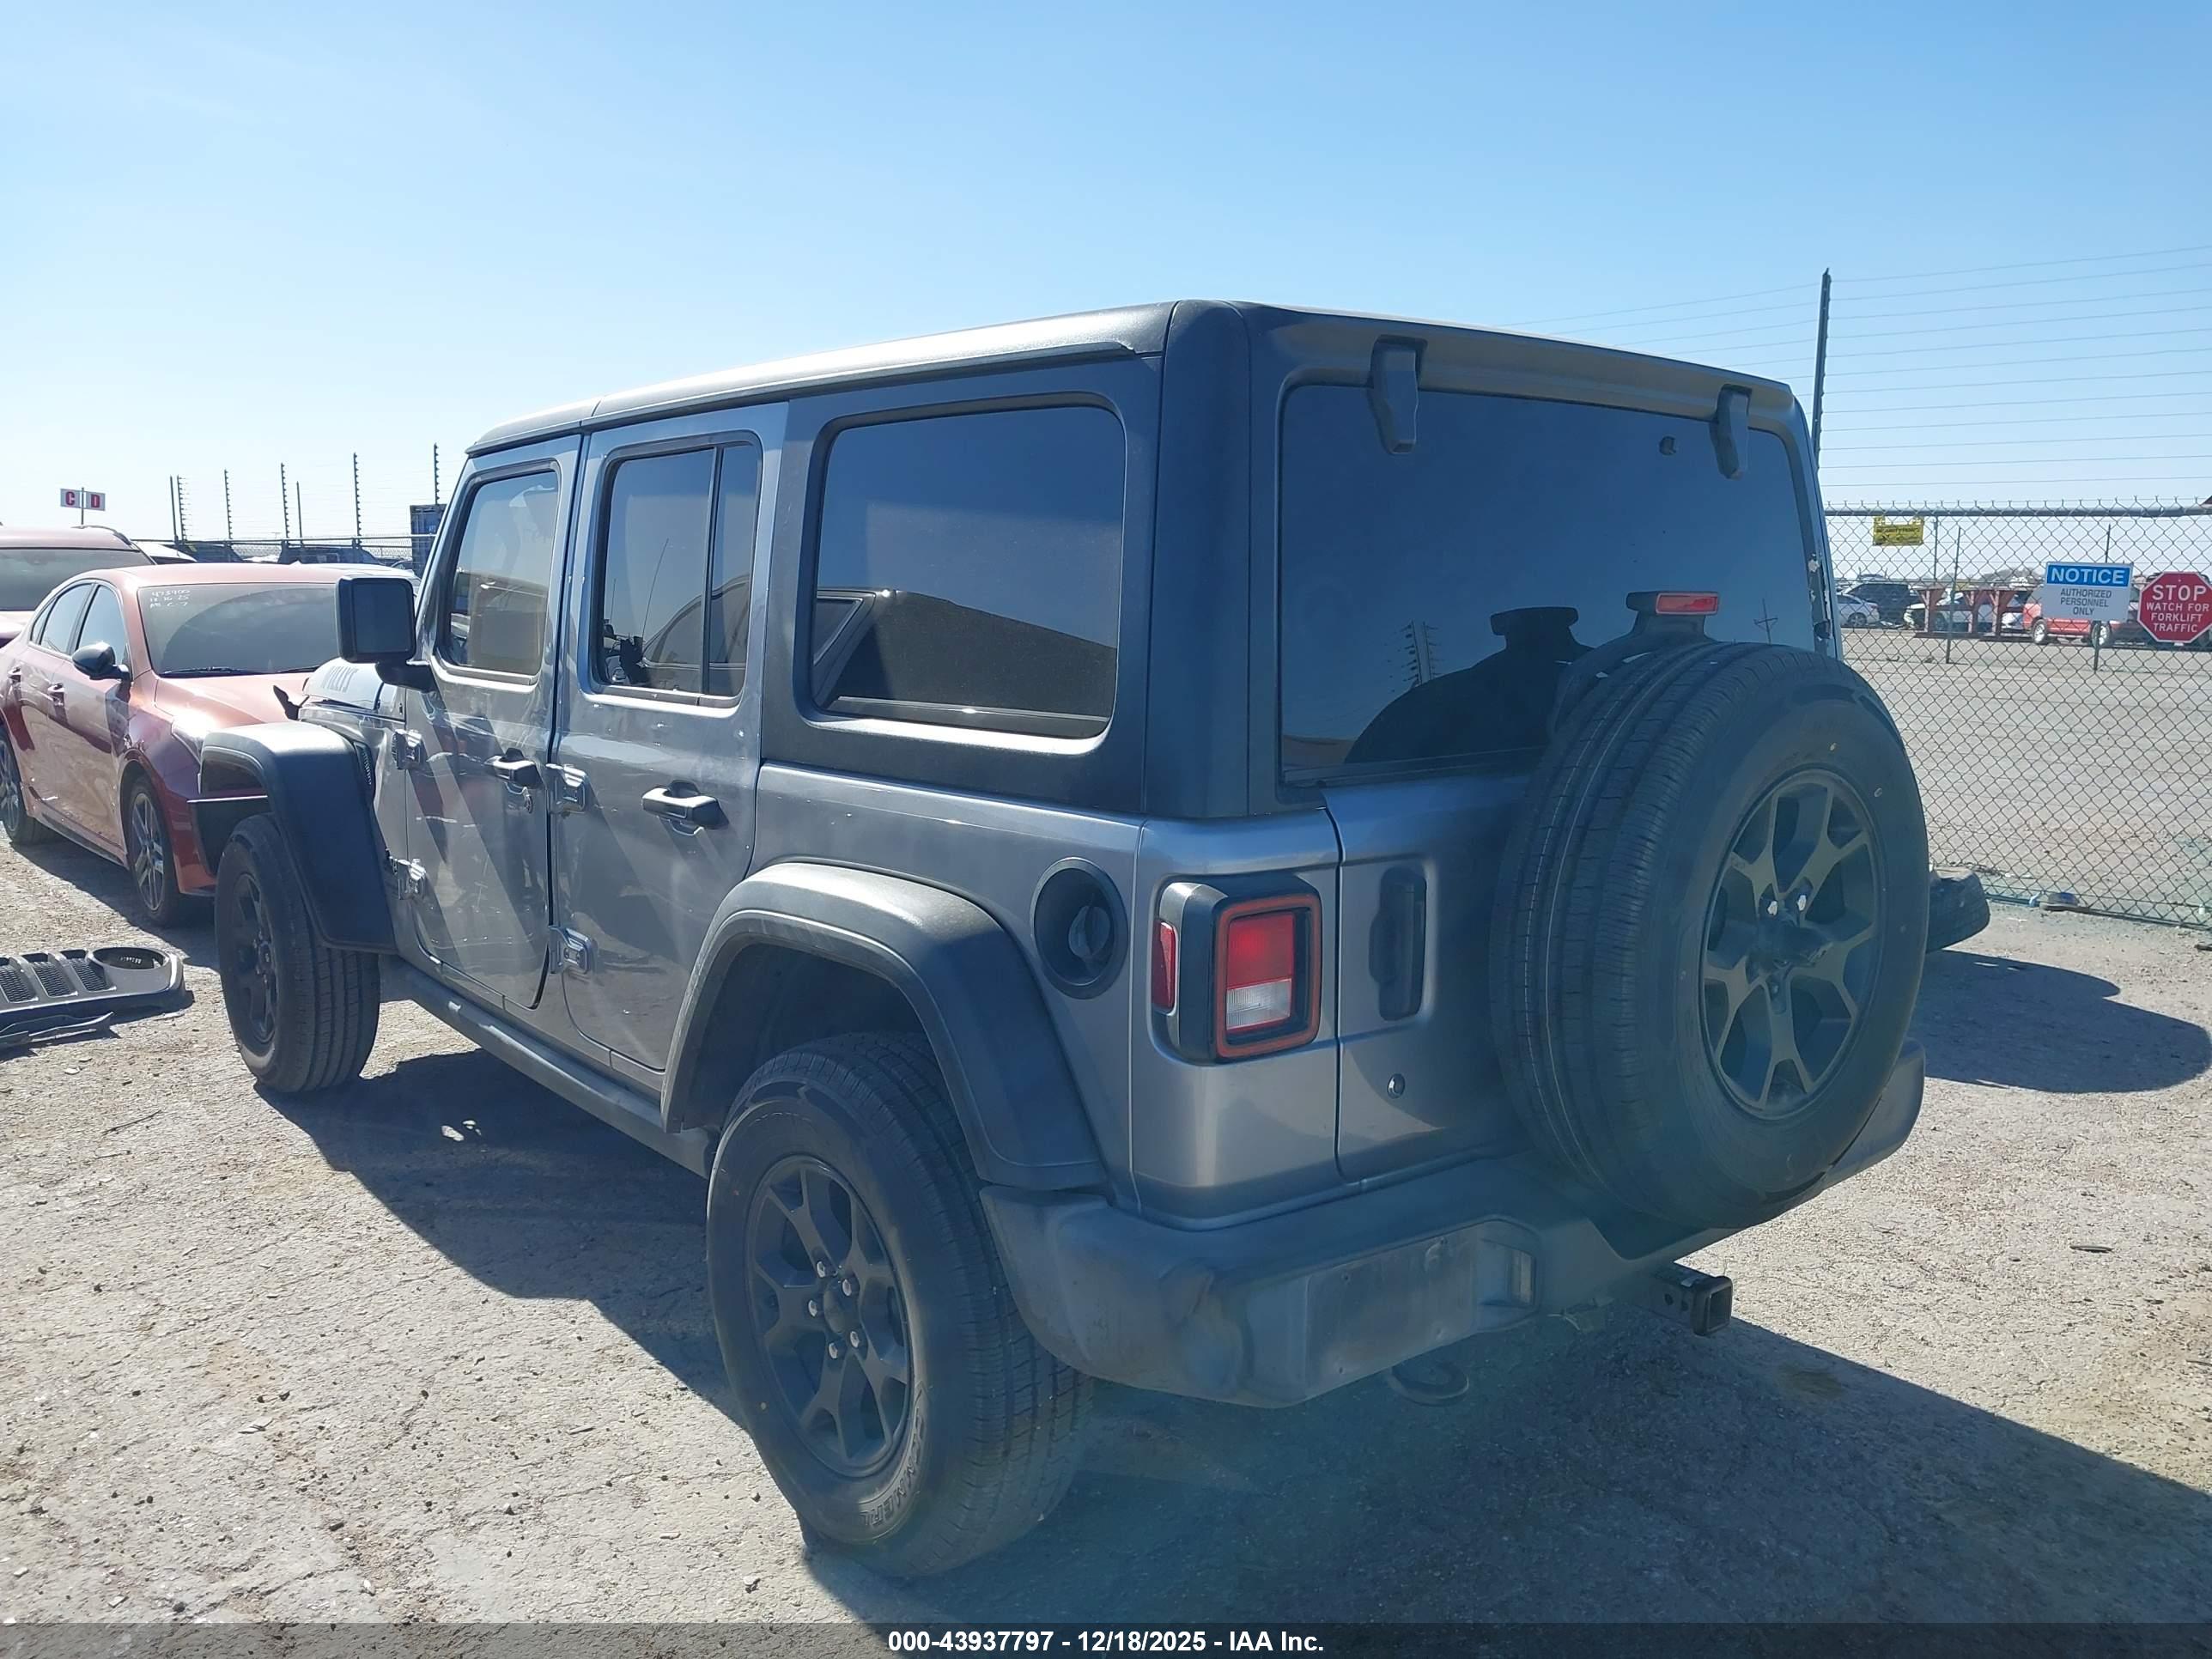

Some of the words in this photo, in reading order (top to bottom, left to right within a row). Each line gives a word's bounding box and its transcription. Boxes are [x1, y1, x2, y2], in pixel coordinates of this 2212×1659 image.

[65, 491, 76, 506] C
[90, 494, 100, 508] D
[2051, 568, 2125, 585] NOTICE
[2061, 588, 2112, 599] AUTHORIZED
[2152, 585, 2207, 601] STOP
[2061, 597, 2109, 608] PERSONNEL
[2147, 603, 2183, 612] WATCH
[2188, 603, 2209, 612] FOR
[2073, 606, 2095, 616] ONLY
[2151, 612, 2203, 623] FORKLIFT
[2153, 623, 2198, 633] TRAFFIC
